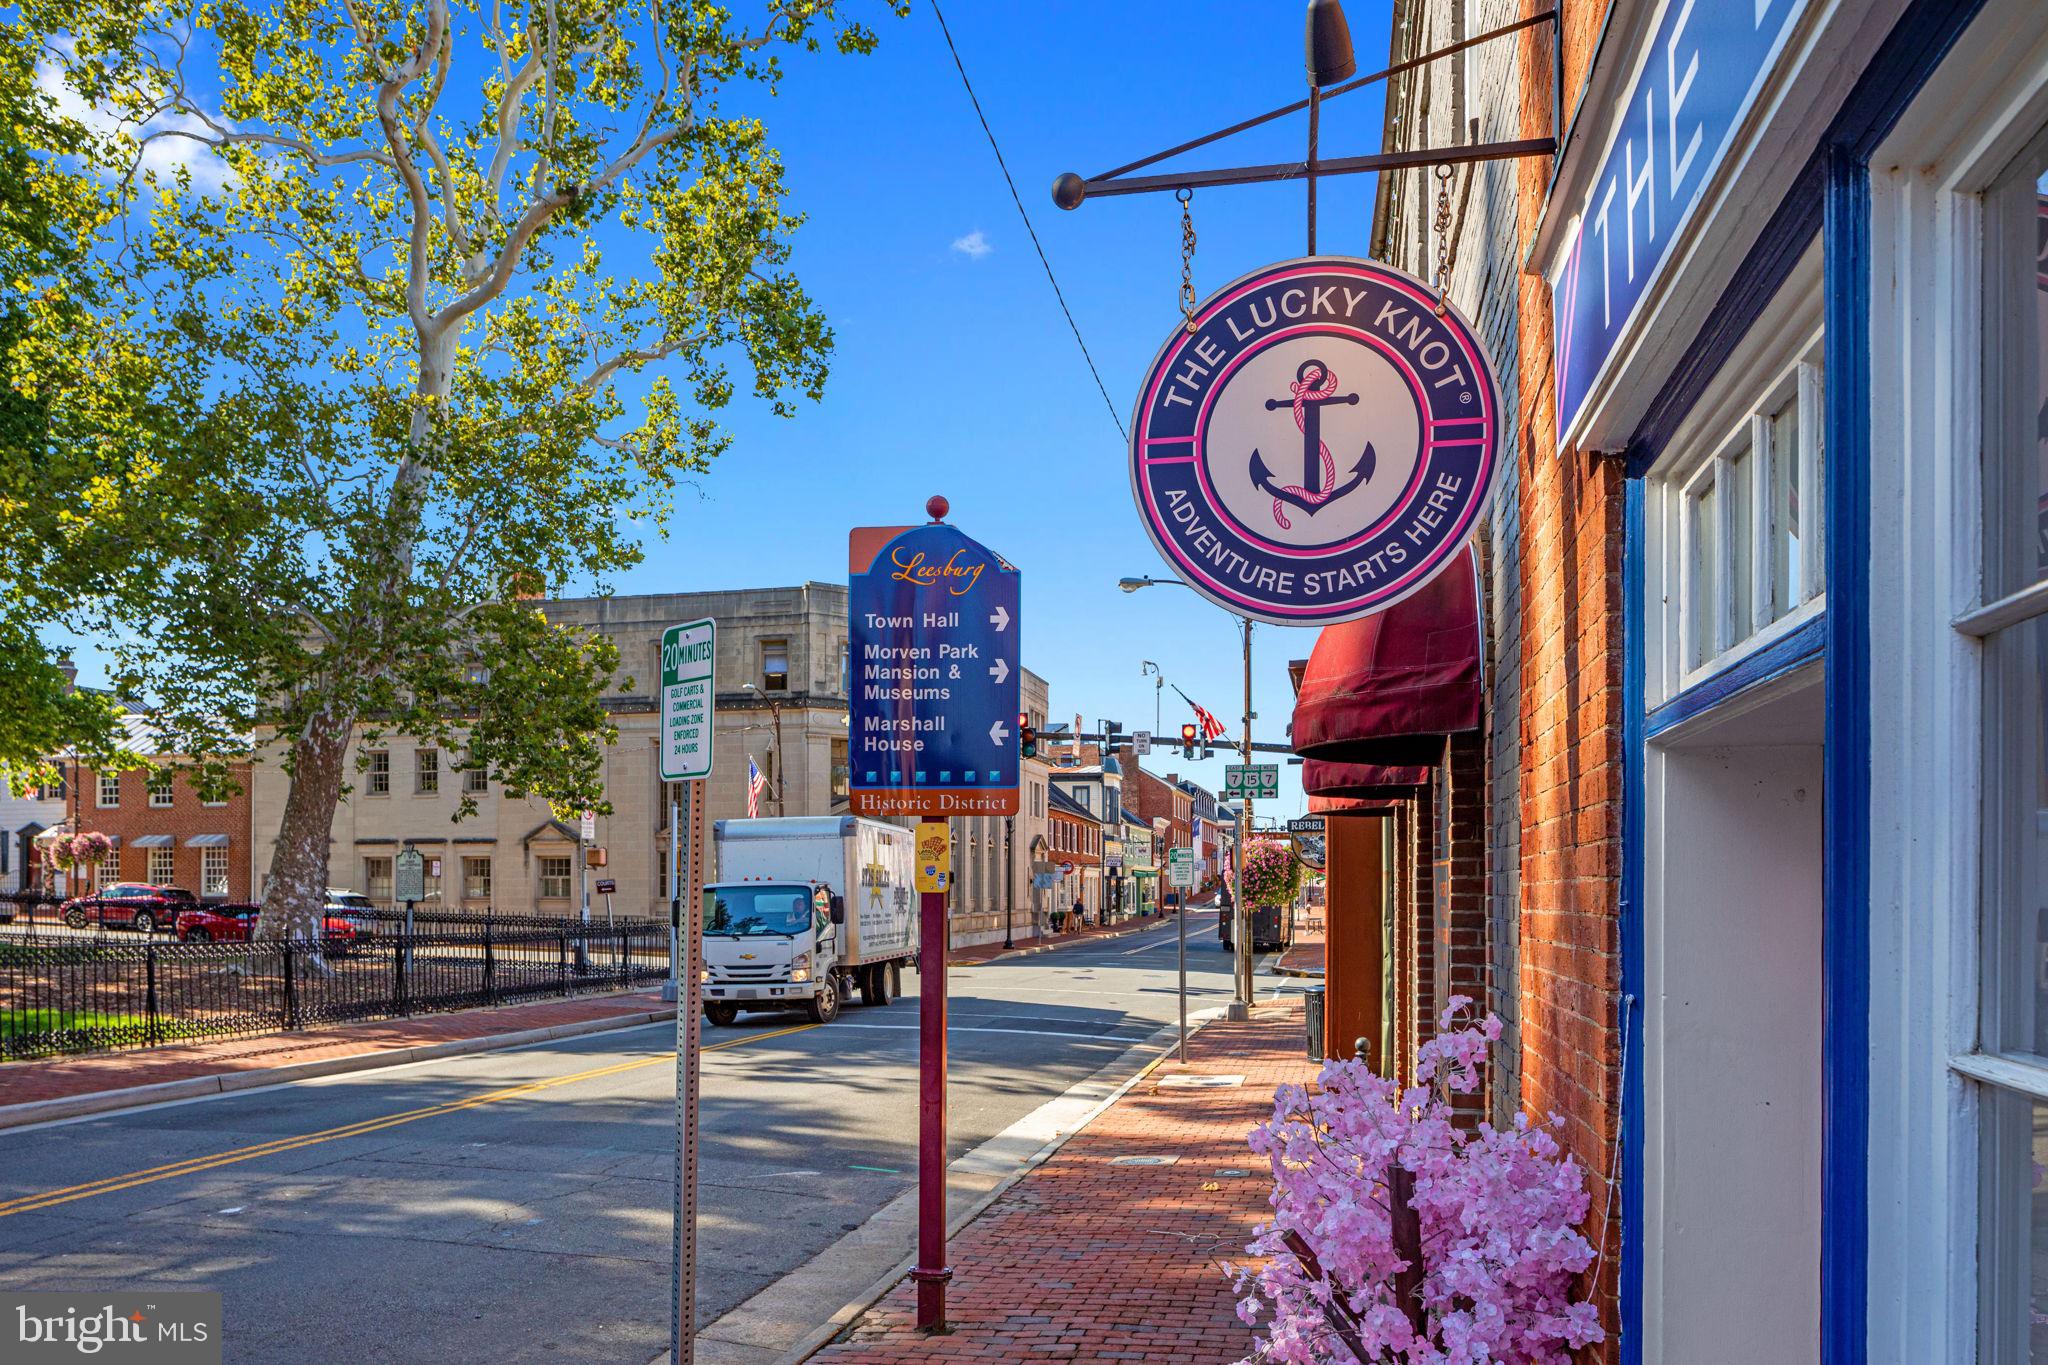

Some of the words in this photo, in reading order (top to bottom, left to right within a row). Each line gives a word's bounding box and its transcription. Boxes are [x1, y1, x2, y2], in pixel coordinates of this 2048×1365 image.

[1594, 0, 1703, 329] THE
[1163, 335, 1227, 408] THE
[1226, 286, 1368, 342] LUCKY
[1165, 488, 1295, 595] ADVENTURE
[1303, 542, 1407, 596] STARTS
[1405, 472, 1462, 547] HERE
[891, 546, 985, 596] Leesburg
[865, 613, 913, 629] Town
[923, 612, 959, 628] Hall
[664, 643, 678, 672] 20
[678, 640, 712, 666] MINUTES
[864, 644, 931, 660] Morven
[939, 643, 979, 659] Park
[864, 664, 940, 680] Mansion
[948, 664, 961, 680] &
[670, 687, 683, 699] GOLF
[683, 685, 699, 697] CARTS
[699, 684, 705, 694] &
[864, 685, 950, 700] Museums
[672, 699, 704, 712] COMMERCIAL
[669, 715, 690, 728] LOADING
[690, 712, 704, 725] ZONE
[864, 716, 945, 731] Marshall
[673, 727, 699, 740] ENFORCED
[674, 744, 681, 754] 24
[681, 742, 698, 753] HOURS
[864, 736, 925, 752] House
[1231, 774, 1238, 785] 7
[1247, 775, 1257, 785] 15
[1265, 774, 1272, 784] 7
[860, 794, 931, 811] Historic
[940, 794, 1007, 810] District
[1291, 821, 1325, 831] REBEL
[1170, 851, 1177, 860] 20
